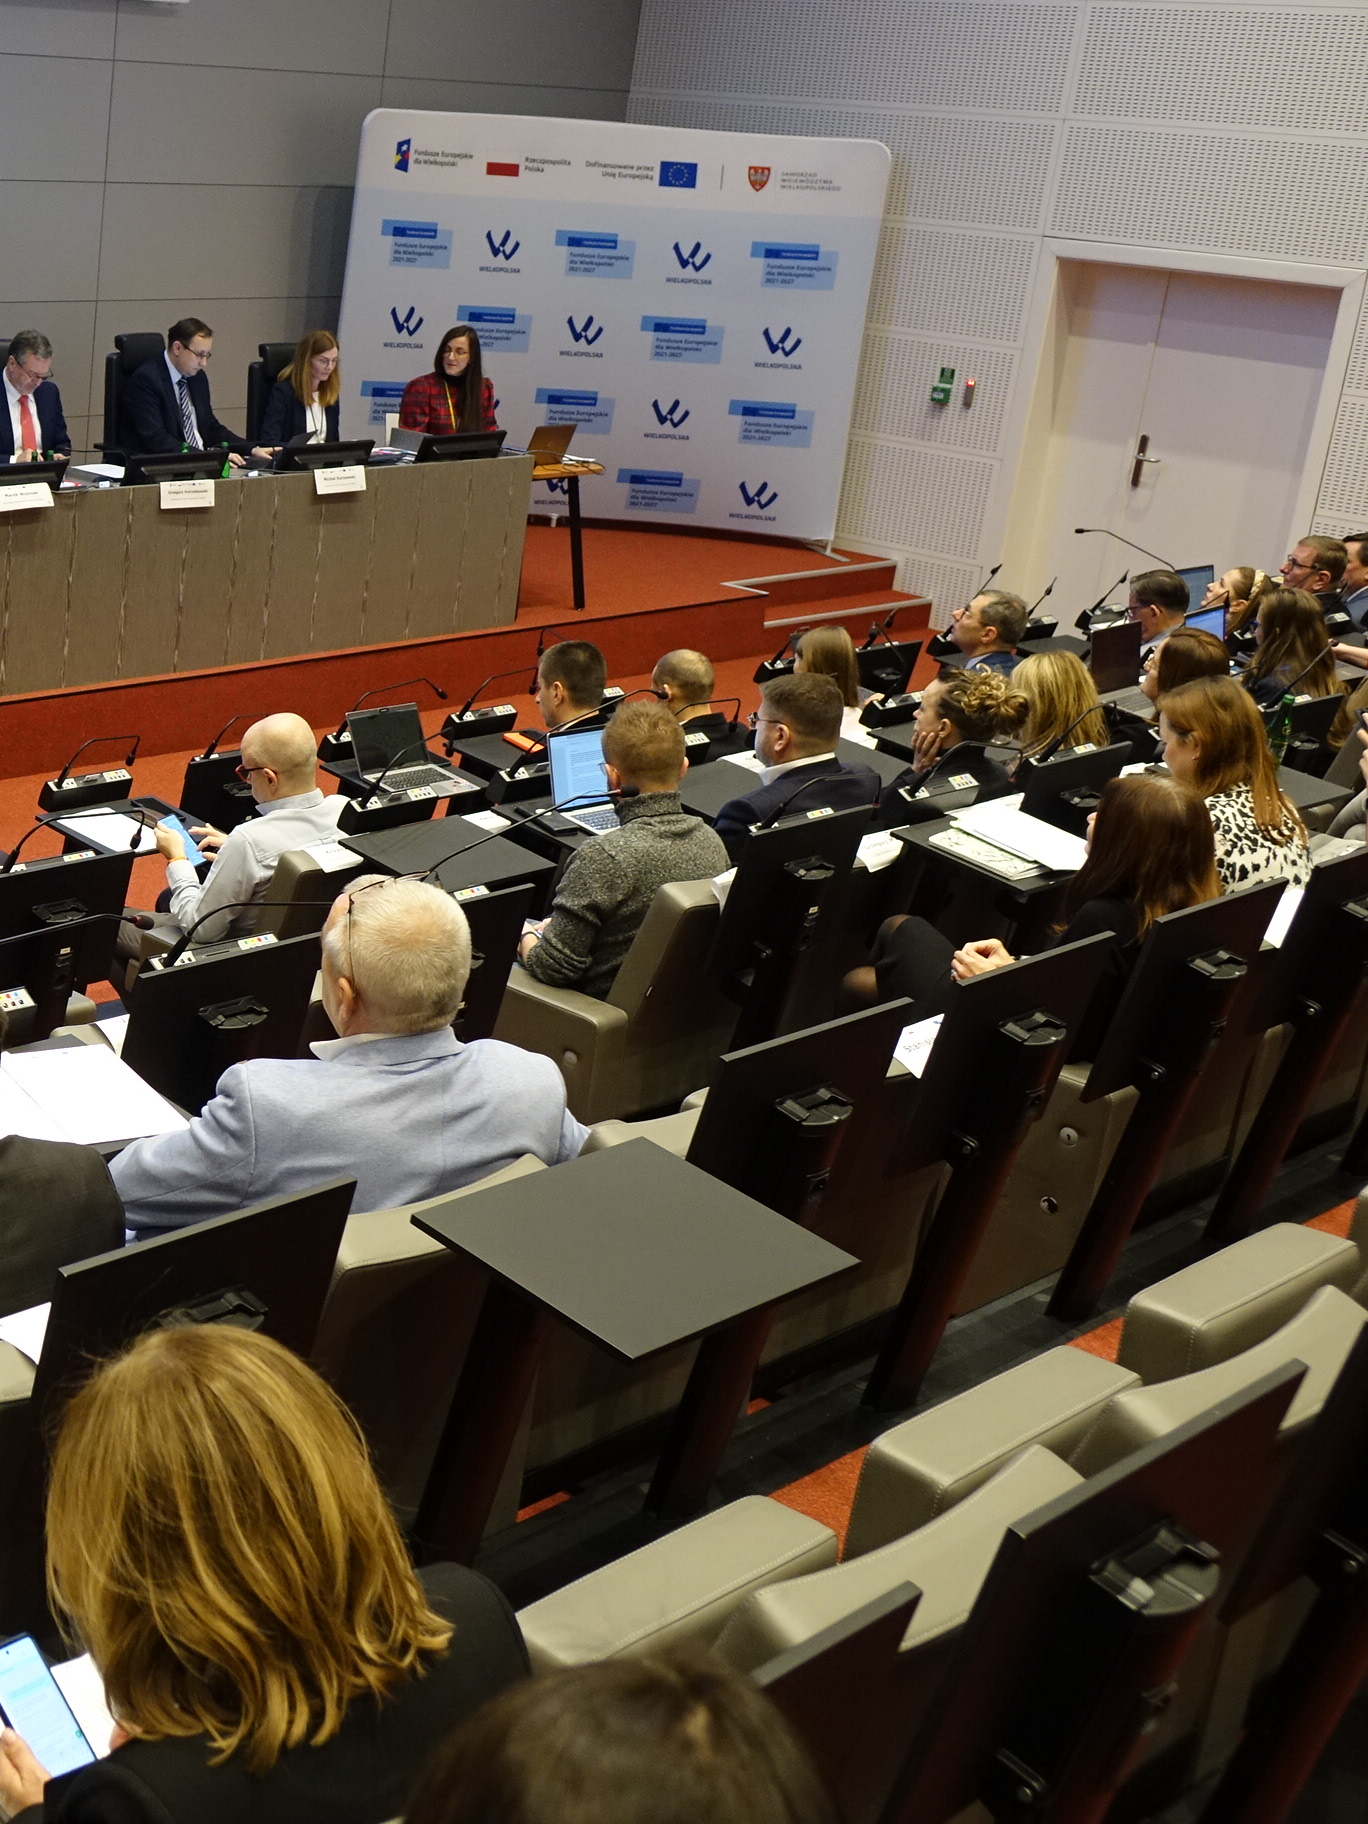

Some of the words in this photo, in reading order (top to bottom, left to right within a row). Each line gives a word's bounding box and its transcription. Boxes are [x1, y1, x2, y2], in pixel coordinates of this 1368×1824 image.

[525, 156, 572, 166] Rzeczpospolita
[585, 160, 635, 171] Dofinansowane
[525, 165, 544, 173] Polska
[382, 341, 424, 350] WIELKOPOLSKA
